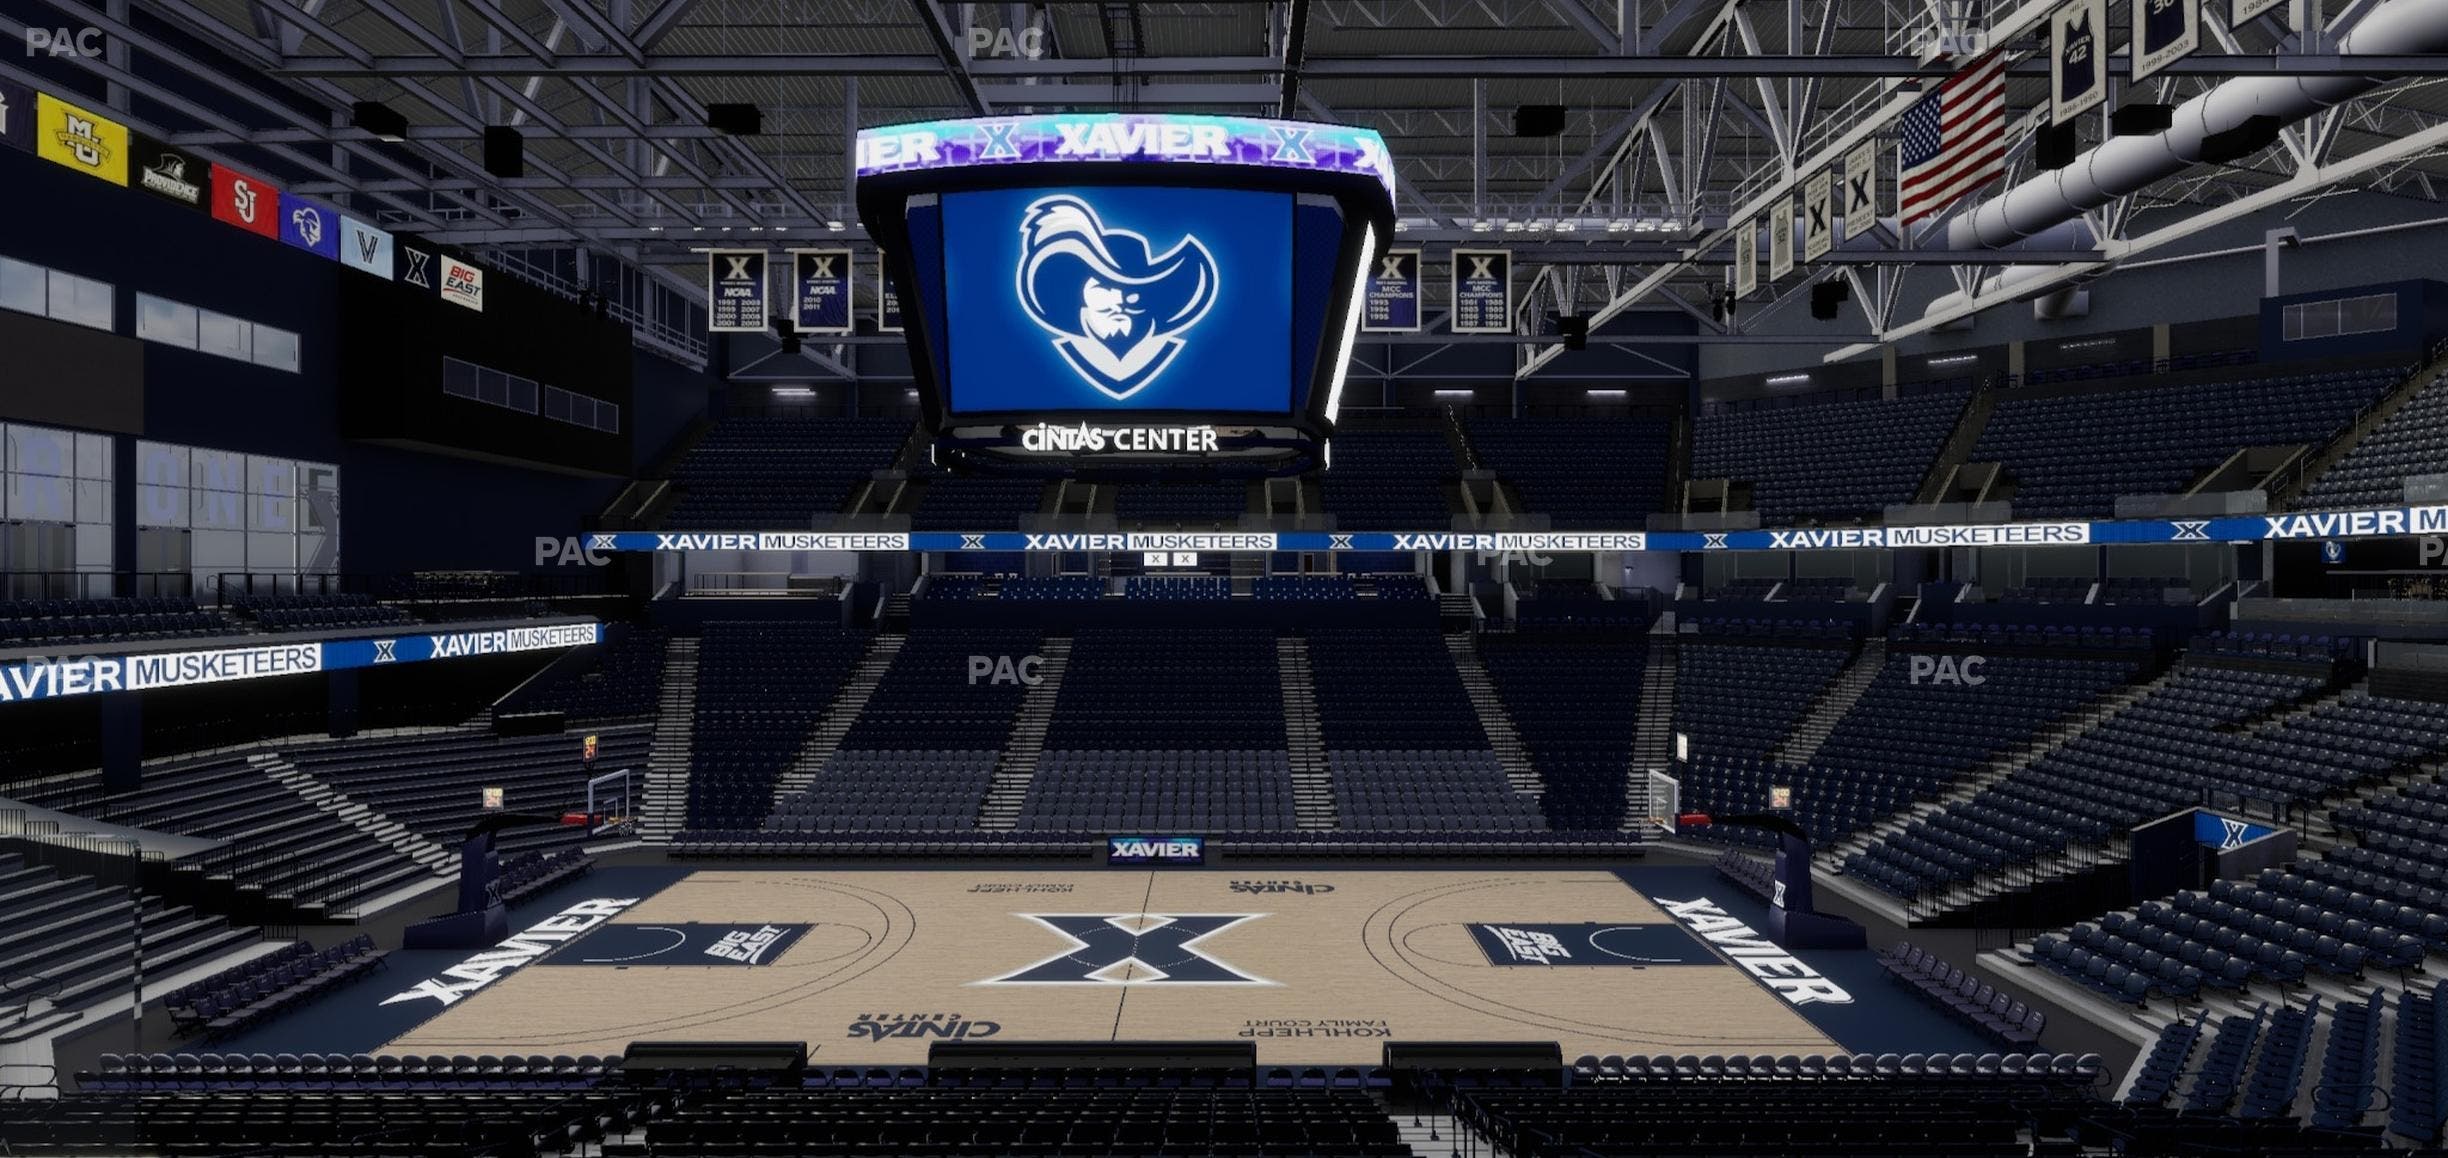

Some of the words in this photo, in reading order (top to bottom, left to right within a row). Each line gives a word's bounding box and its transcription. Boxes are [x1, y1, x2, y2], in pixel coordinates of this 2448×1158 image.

[2069, 45, 2087, 64] 42
[979, 122, 1022, 159] X
[1055, 123, 1232, 156] XAVIER
[1270, 126, 1315, 164] X
[1850, 168, 1870, 214] X
[1810, 198, 1827, 238] X
[357, 230, 378, 264] V
[404, 246, 430, 289] X
[450, 265, 475, 283] BIG
[726, 256, 753, 280] X
[812, 256, 835, 279] X
[1376, 256, 1406, 280] X
[1468, 256, 1496, 280] X
[446, 277, 481, 296] EAST
[1114, 428, 1219, 451] CENTER
[1768, 529, 1884, 549] XAVIER
[1894, 525, 2084, 544] MUSKETEERS
[2170, 521, 2211, 540] X
[2265, 511, 2406, 539] XAVIER
[656, 534, 757, 550] XAVIER
[765, 535, 905, 549] MUSKETEERS
[961, 534, 985, 549] X
[1025, 534, 1126, 550] XAVIER
[1133, 534, 1274, 549] MUSKETEERS
[1329, 534, 1353, 549] X
[1393, 533, 1495, 550] XAVIER
[1501, 534, 1642, 549] MUSKETEERS
[1703, 533, 1728, 549] X
[373, 640, 397, 663] X
[430, 632, 505, 659] XAVIER
[511, 626, 594, 649] MUSKETEERS
[136, 648, 317, 685] MUSKETEERS
[2221, 818, 2249, 849] X
[1111, 841, 1200, 858] XAVIER
[378, 898, 640, 1006] XAVIER
[704, 930, 752, 957] BIG
[725, 925, 780, 962] EAST
[960, 913, 1288, 987] X
[1499, 927, 1550, 965] EAST
[1526, 931, 1572, 958] BIG
[1653, 897, 1855, 1005] XAVIER
[1238, 1028, 1392, 1037] KOHLHEPP
